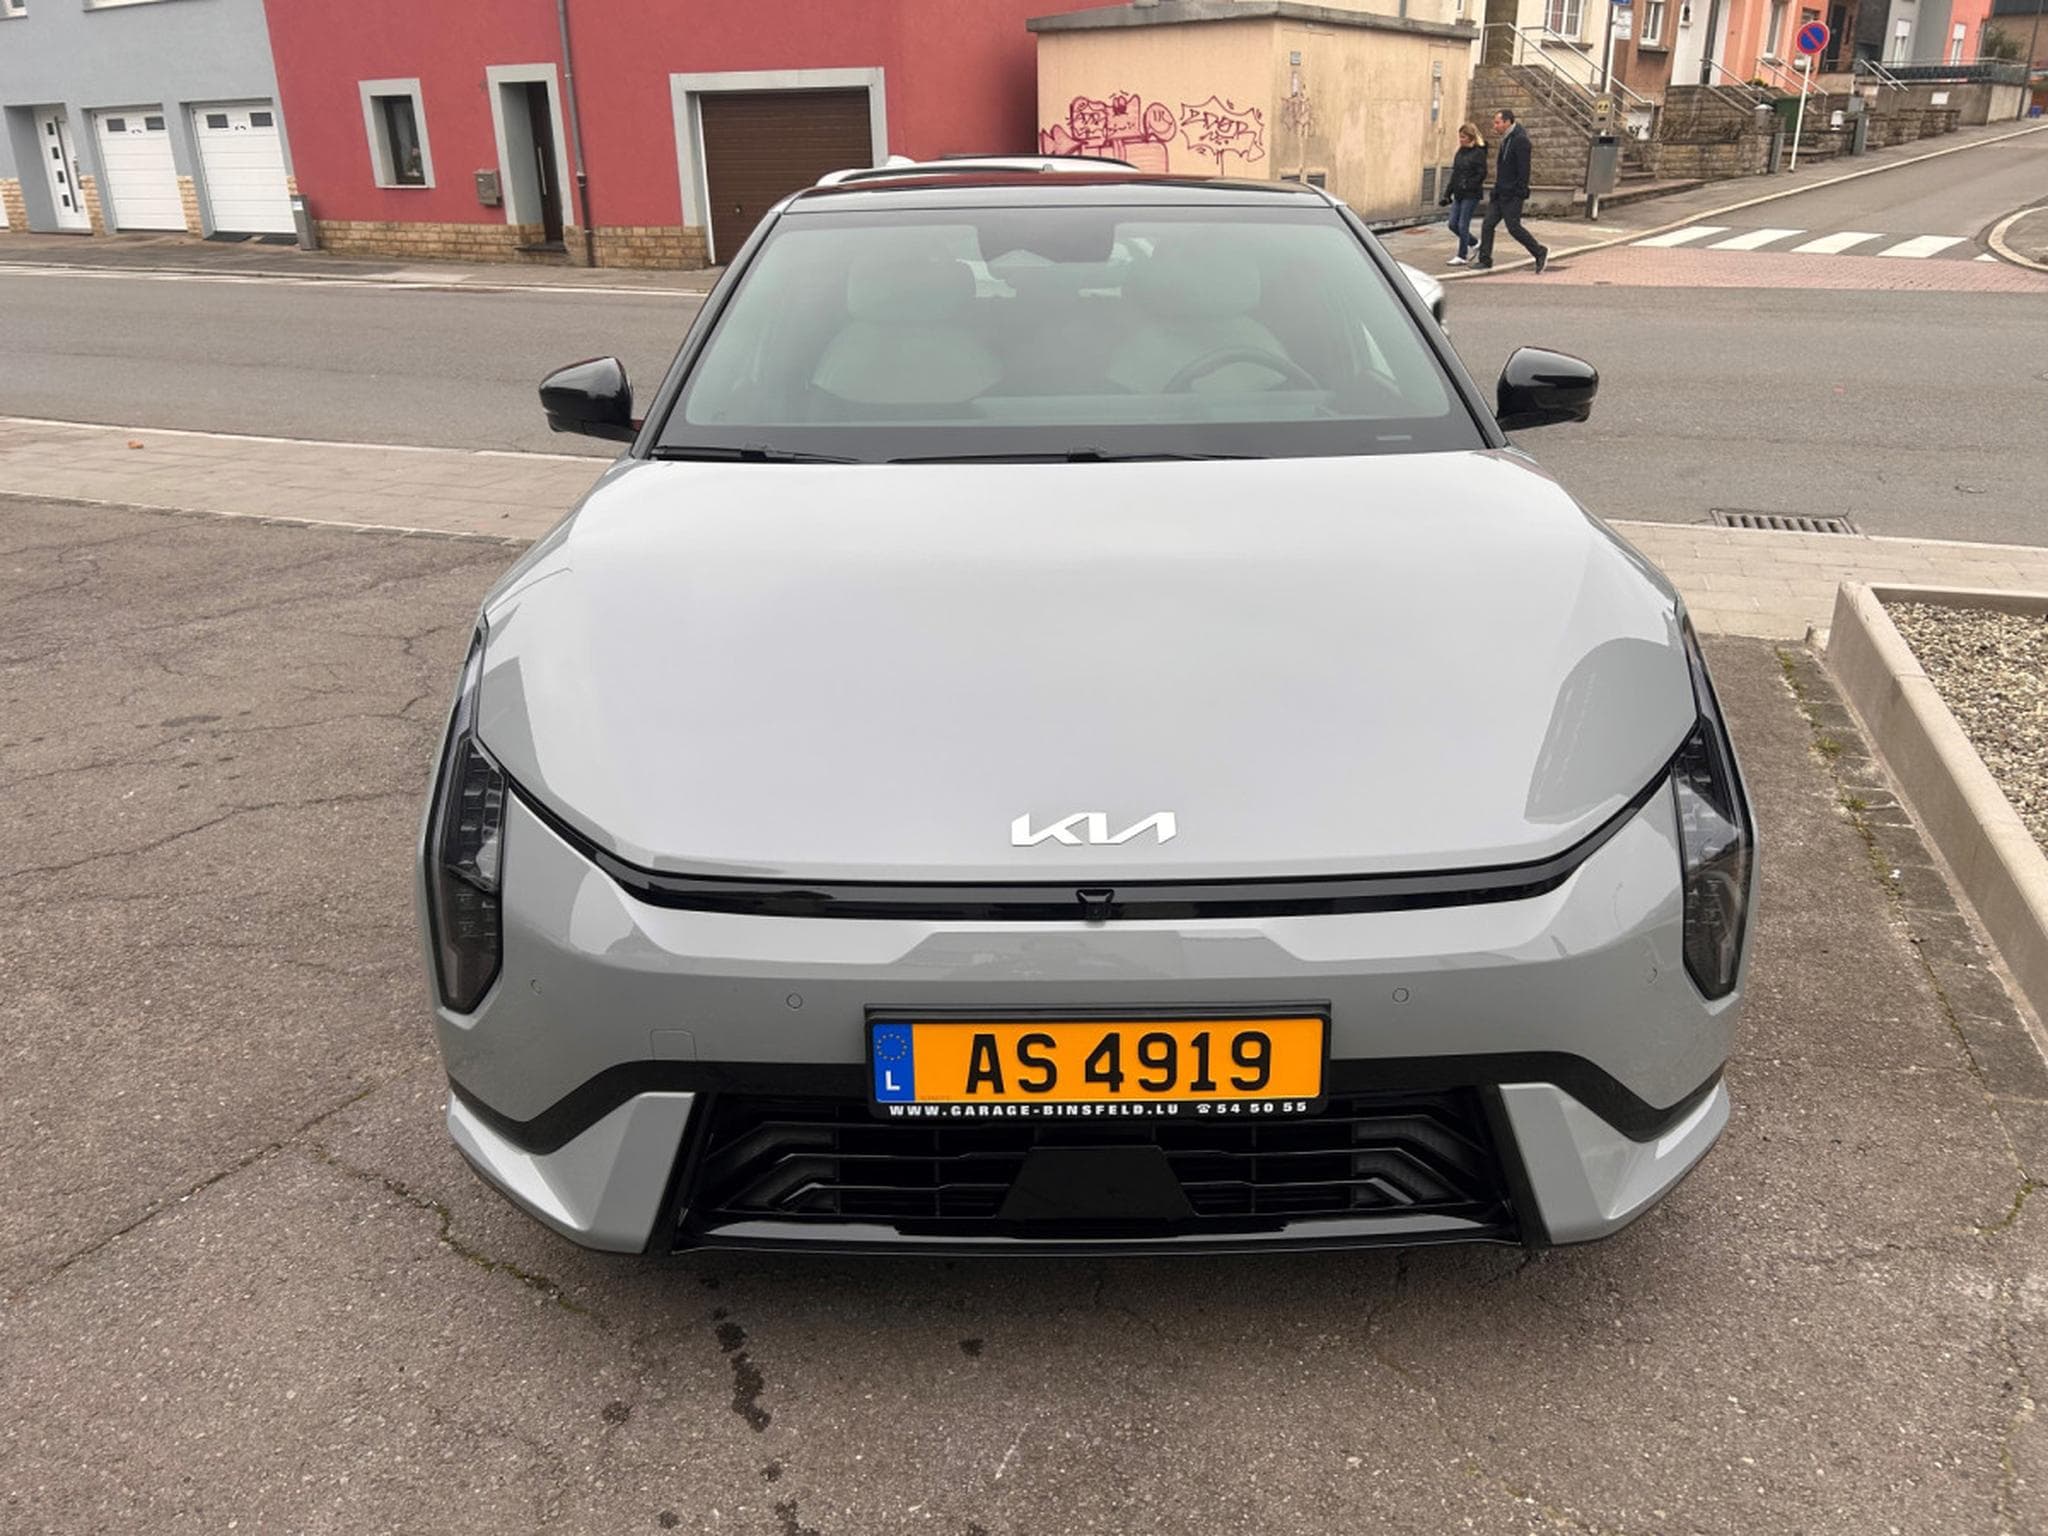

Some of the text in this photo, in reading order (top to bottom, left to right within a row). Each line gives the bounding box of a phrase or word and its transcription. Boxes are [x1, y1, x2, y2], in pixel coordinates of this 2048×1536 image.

[1011, 811, 1177, 847] KIA
[965, 1031, 1272, 1094] AS 4919
[885, 1070, 901, 1091] L
[889, 1102, 1307, 1117] WWW.GARAGE-BINSFELD.LU 54 50 55
